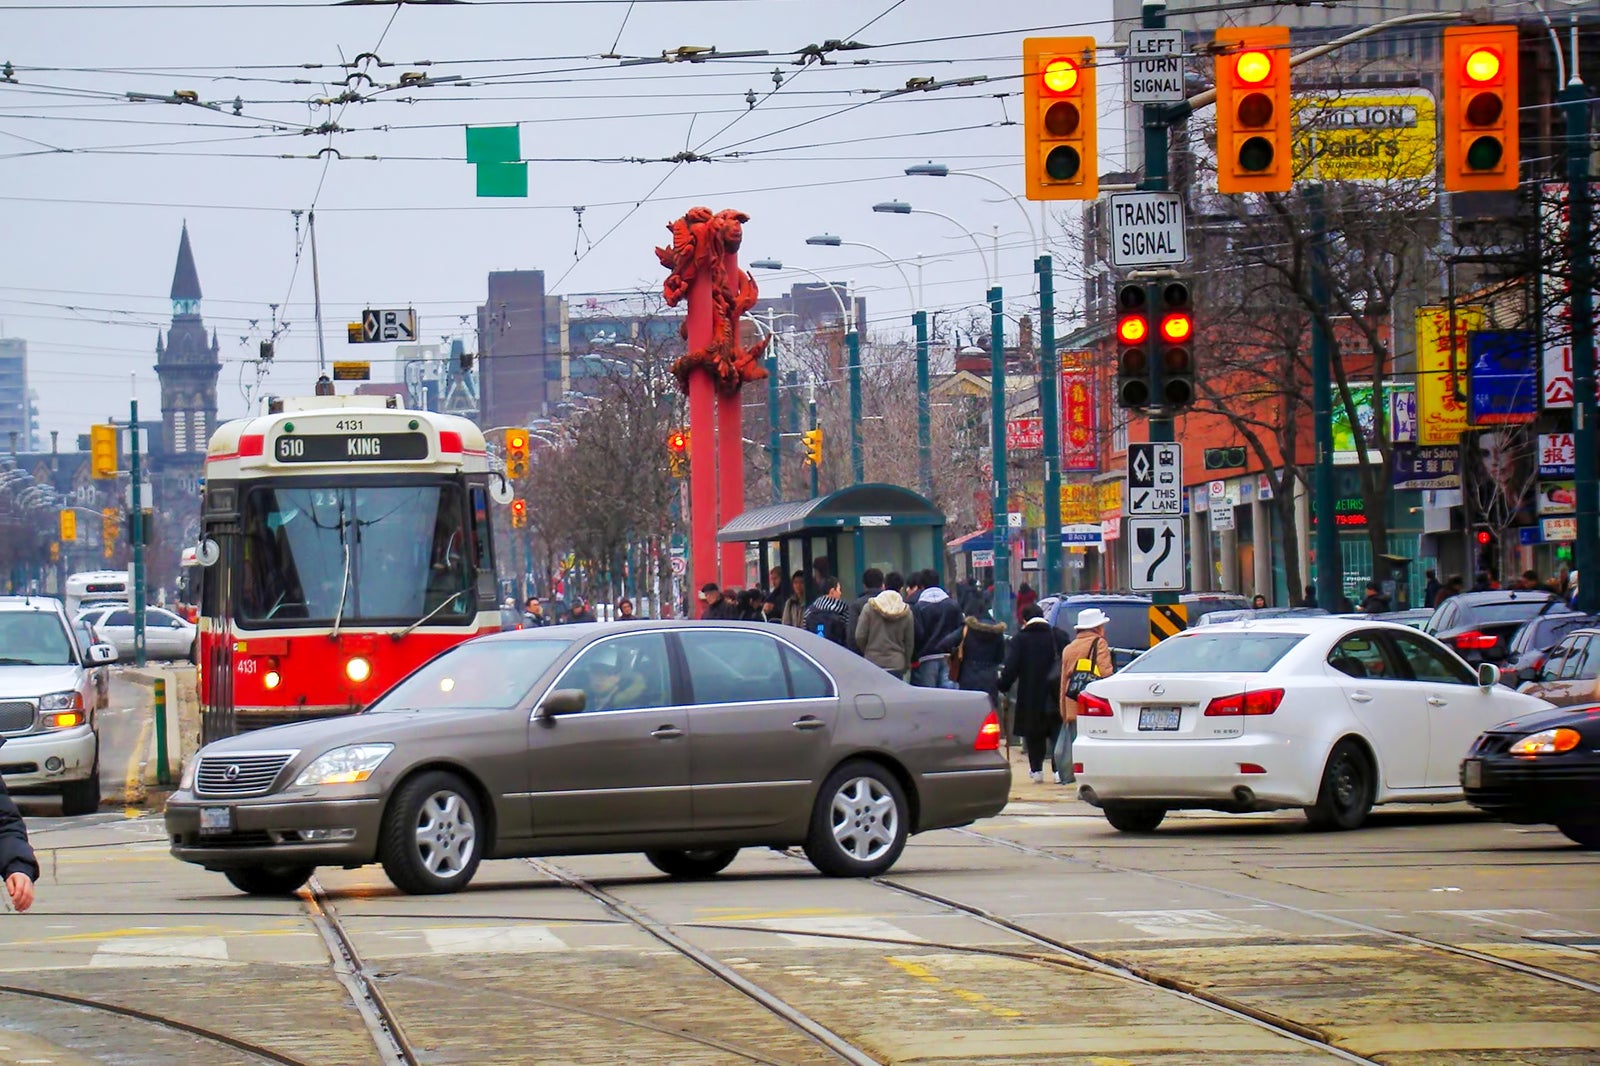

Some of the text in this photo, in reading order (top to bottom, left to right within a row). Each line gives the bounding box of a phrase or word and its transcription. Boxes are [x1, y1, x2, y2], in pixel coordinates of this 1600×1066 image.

[1138, 39, 1175, 53] LEFT
[1138, 59, 1178, 73] TURN
[1133, 79, 1181, 93] SIGNAL
[1115, 200, 1179, 228] TRANSIT
[1122, 230, 1177, 256] SIGNAL
[336, 420, 363, 431] 4131
[280, 437, 381, 457] 510 KING
[1433, 447, 1459, 459] Salon
[1155, 488, 1176, 499] THIS
[1152, 500, 1179, 510] LANE
[237, 659, 257, 673] 4131
